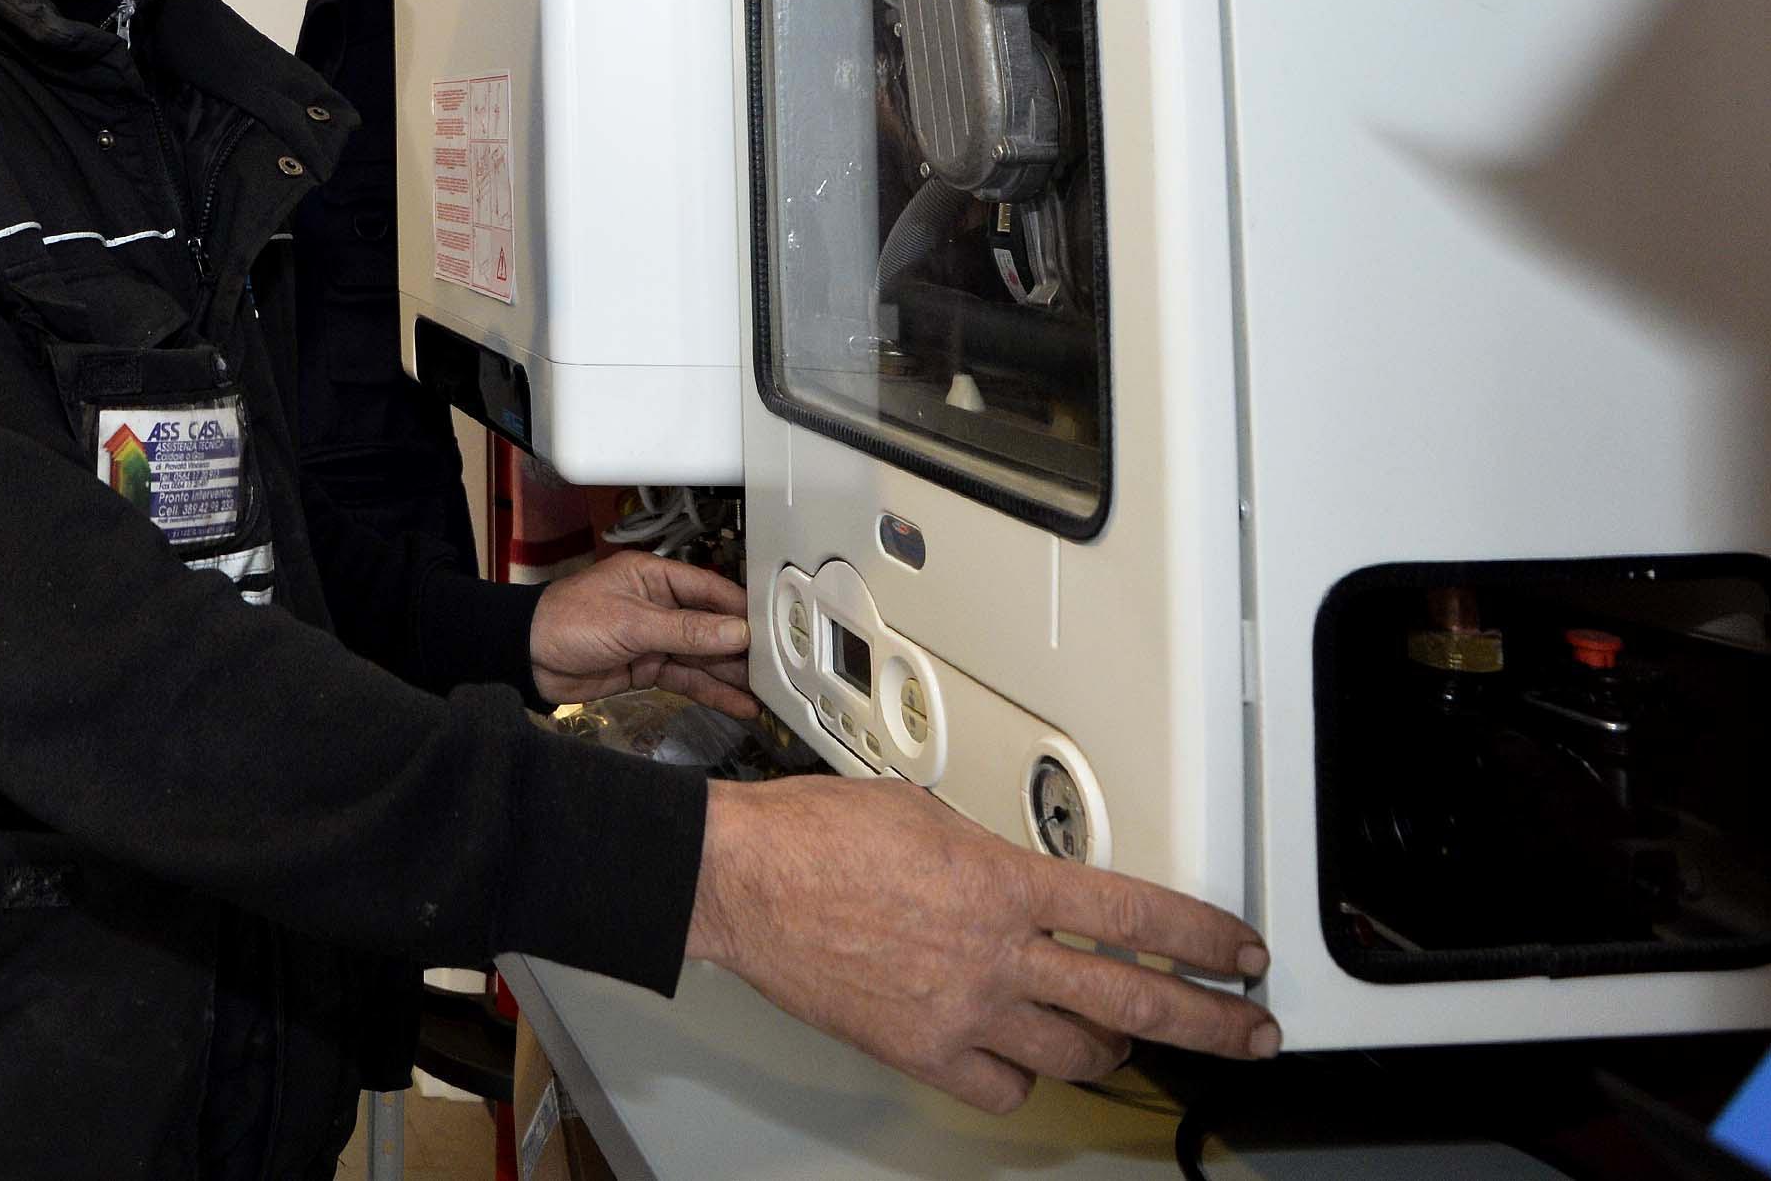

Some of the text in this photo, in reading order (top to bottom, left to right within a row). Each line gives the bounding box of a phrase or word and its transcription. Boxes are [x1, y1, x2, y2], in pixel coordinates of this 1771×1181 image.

[147, 419, 225, 442] ASS CASA
[155, 441, 197, 453] ASSISTENZA
[158, 491, 189, 504] Pronto
